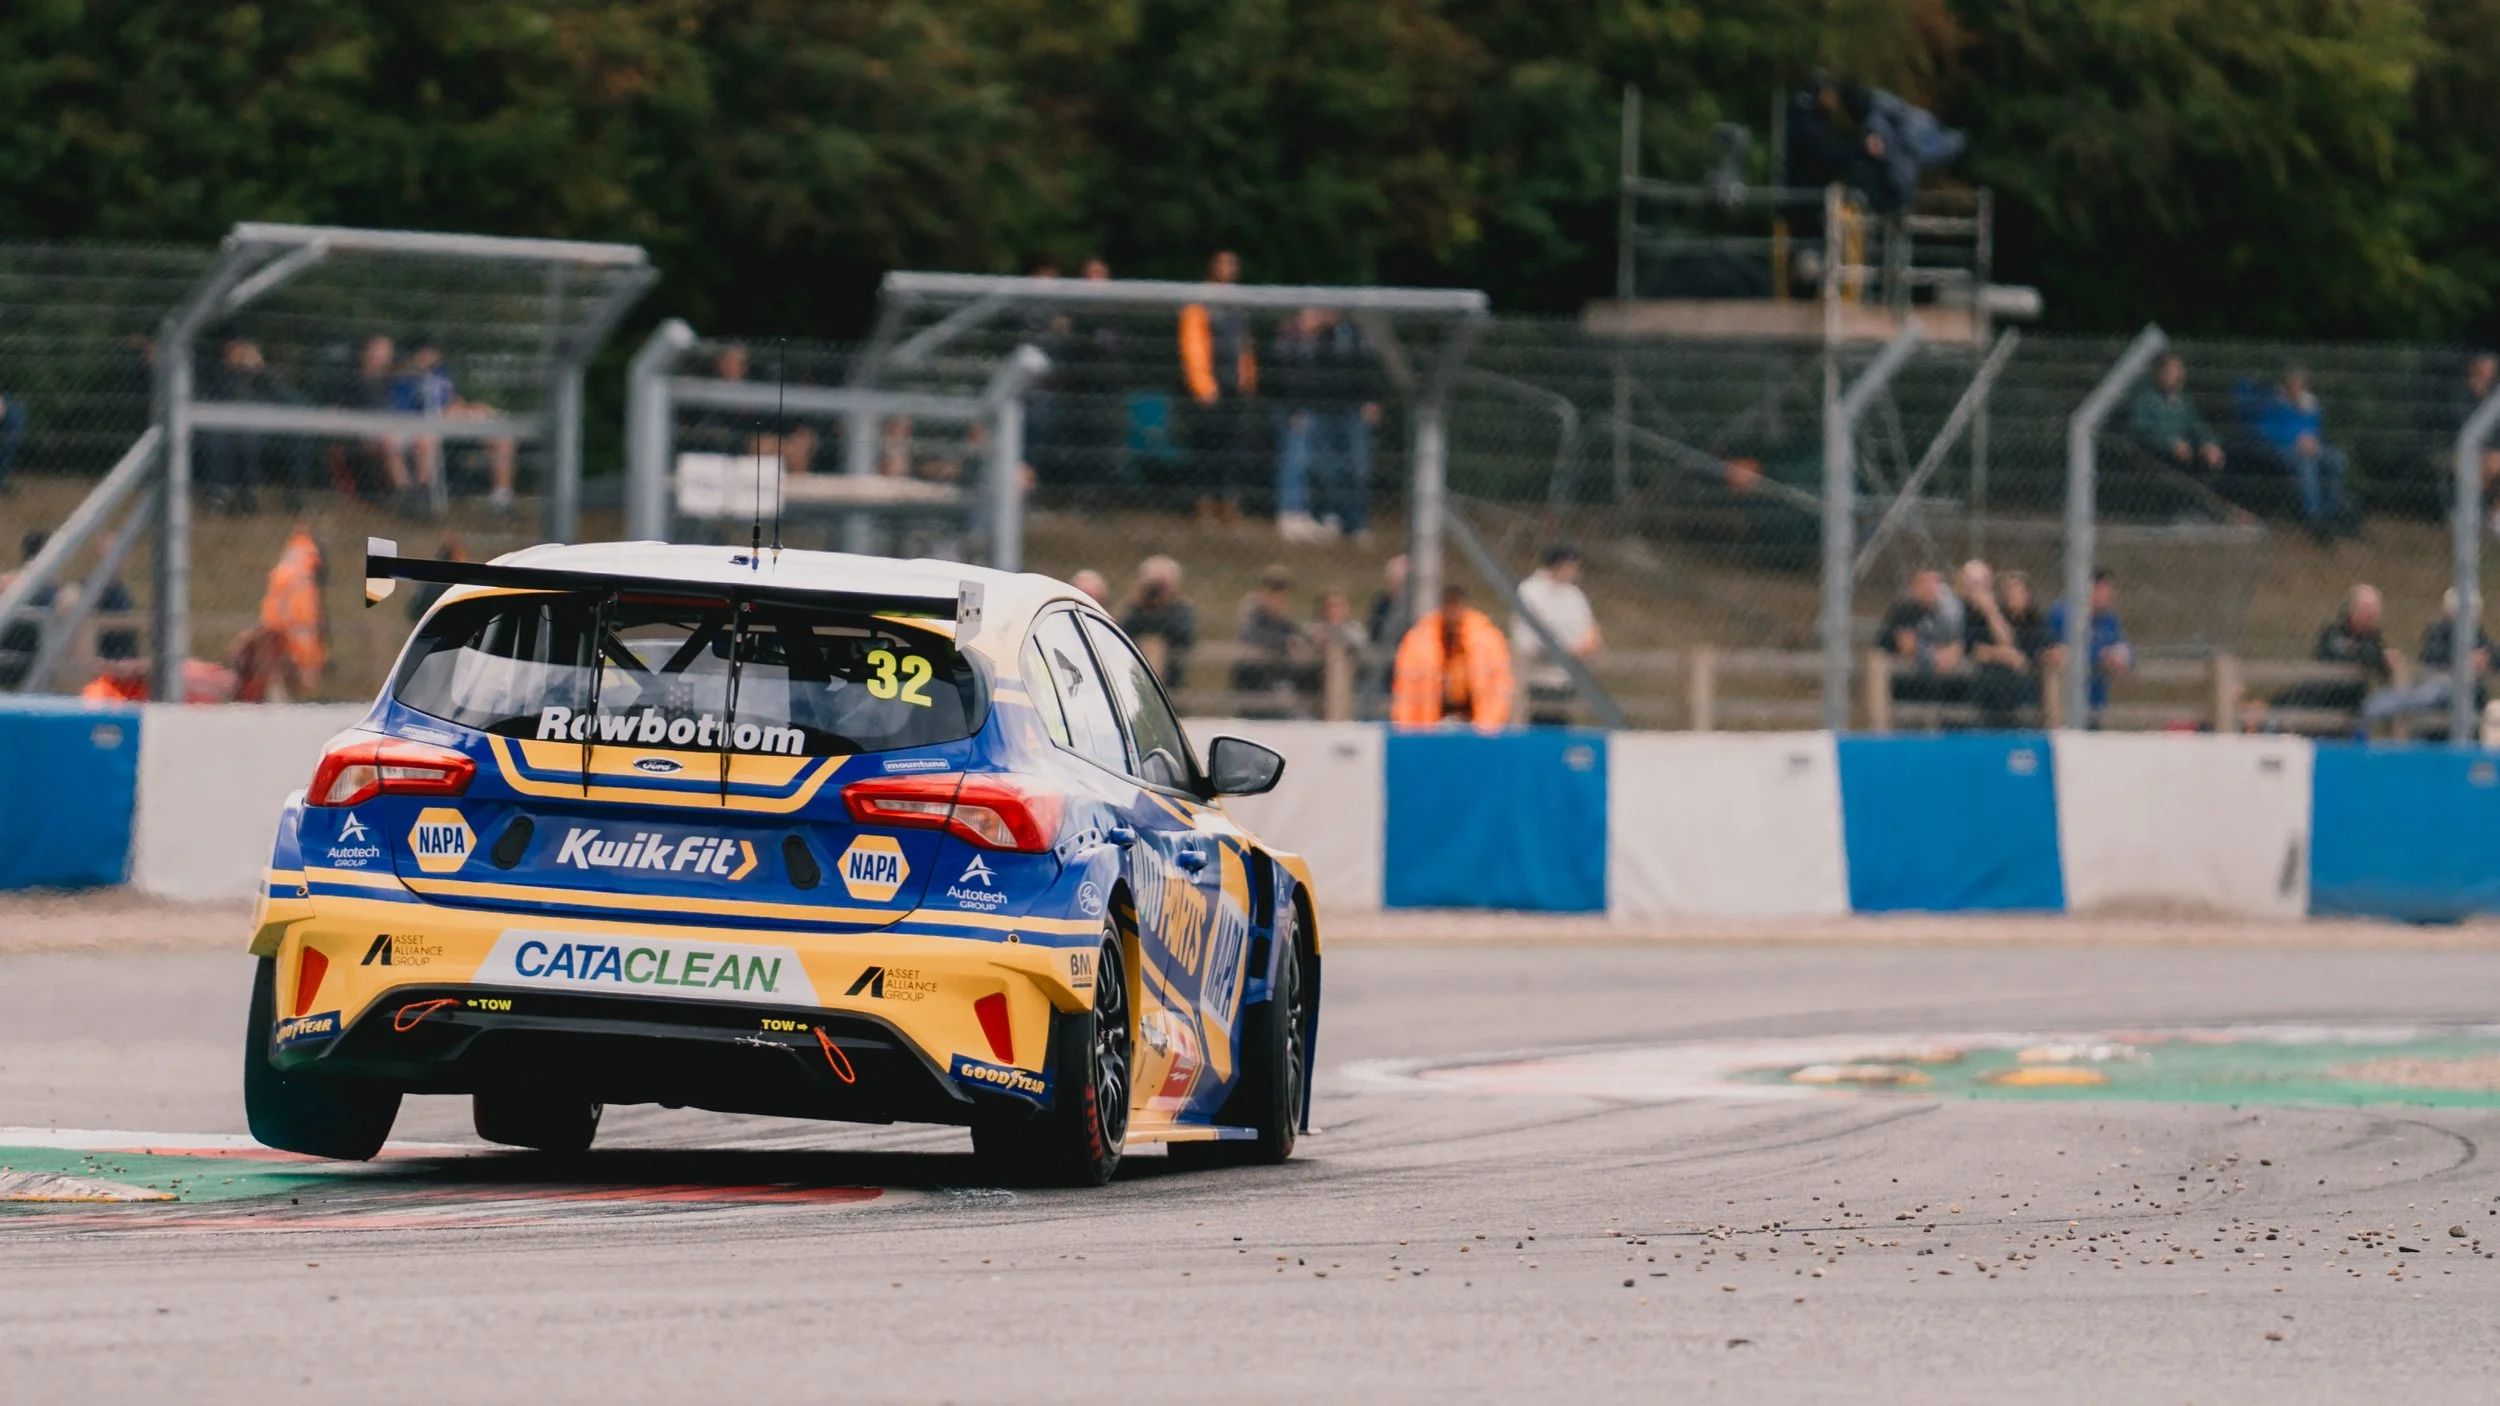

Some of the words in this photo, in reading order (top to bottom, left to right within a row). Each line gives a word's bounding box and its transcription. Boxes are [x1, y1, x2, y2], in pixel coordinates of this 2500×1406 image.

[866, 649, 932, 707] 32
[535, 706, 806, 755] Rowbottom
[887, 760, 948, 770] mountune
[419, 826, 466, 854] NAPA
[327, 845, 380, 859] Autotech
[334, 858, 368, 867] GROUP
[850, 852, 898, 883] NAPA
[946, 885, 1008, 905] Autotech
[959, 900, 997, 911] GROUP
[394, 935, 424, 944] ASSET
[394, 946, 443, 956] ALLIANCE
[393, 957, 430, 966] GROUP
[1071, 954, 1092, 976] BM
[1204, 903, 1244, 1022] NAPA
[886, 969, 919, 979] ASSET
[886, 980, 938, 992] ALLIANCE
[885, 990, 924, 1001] GROUP
[479, 999, 512, 1010] TOW
[761, 1019, 796, 1031] TOW
[961, 1063, 1045, 1094] GOODYEAR
